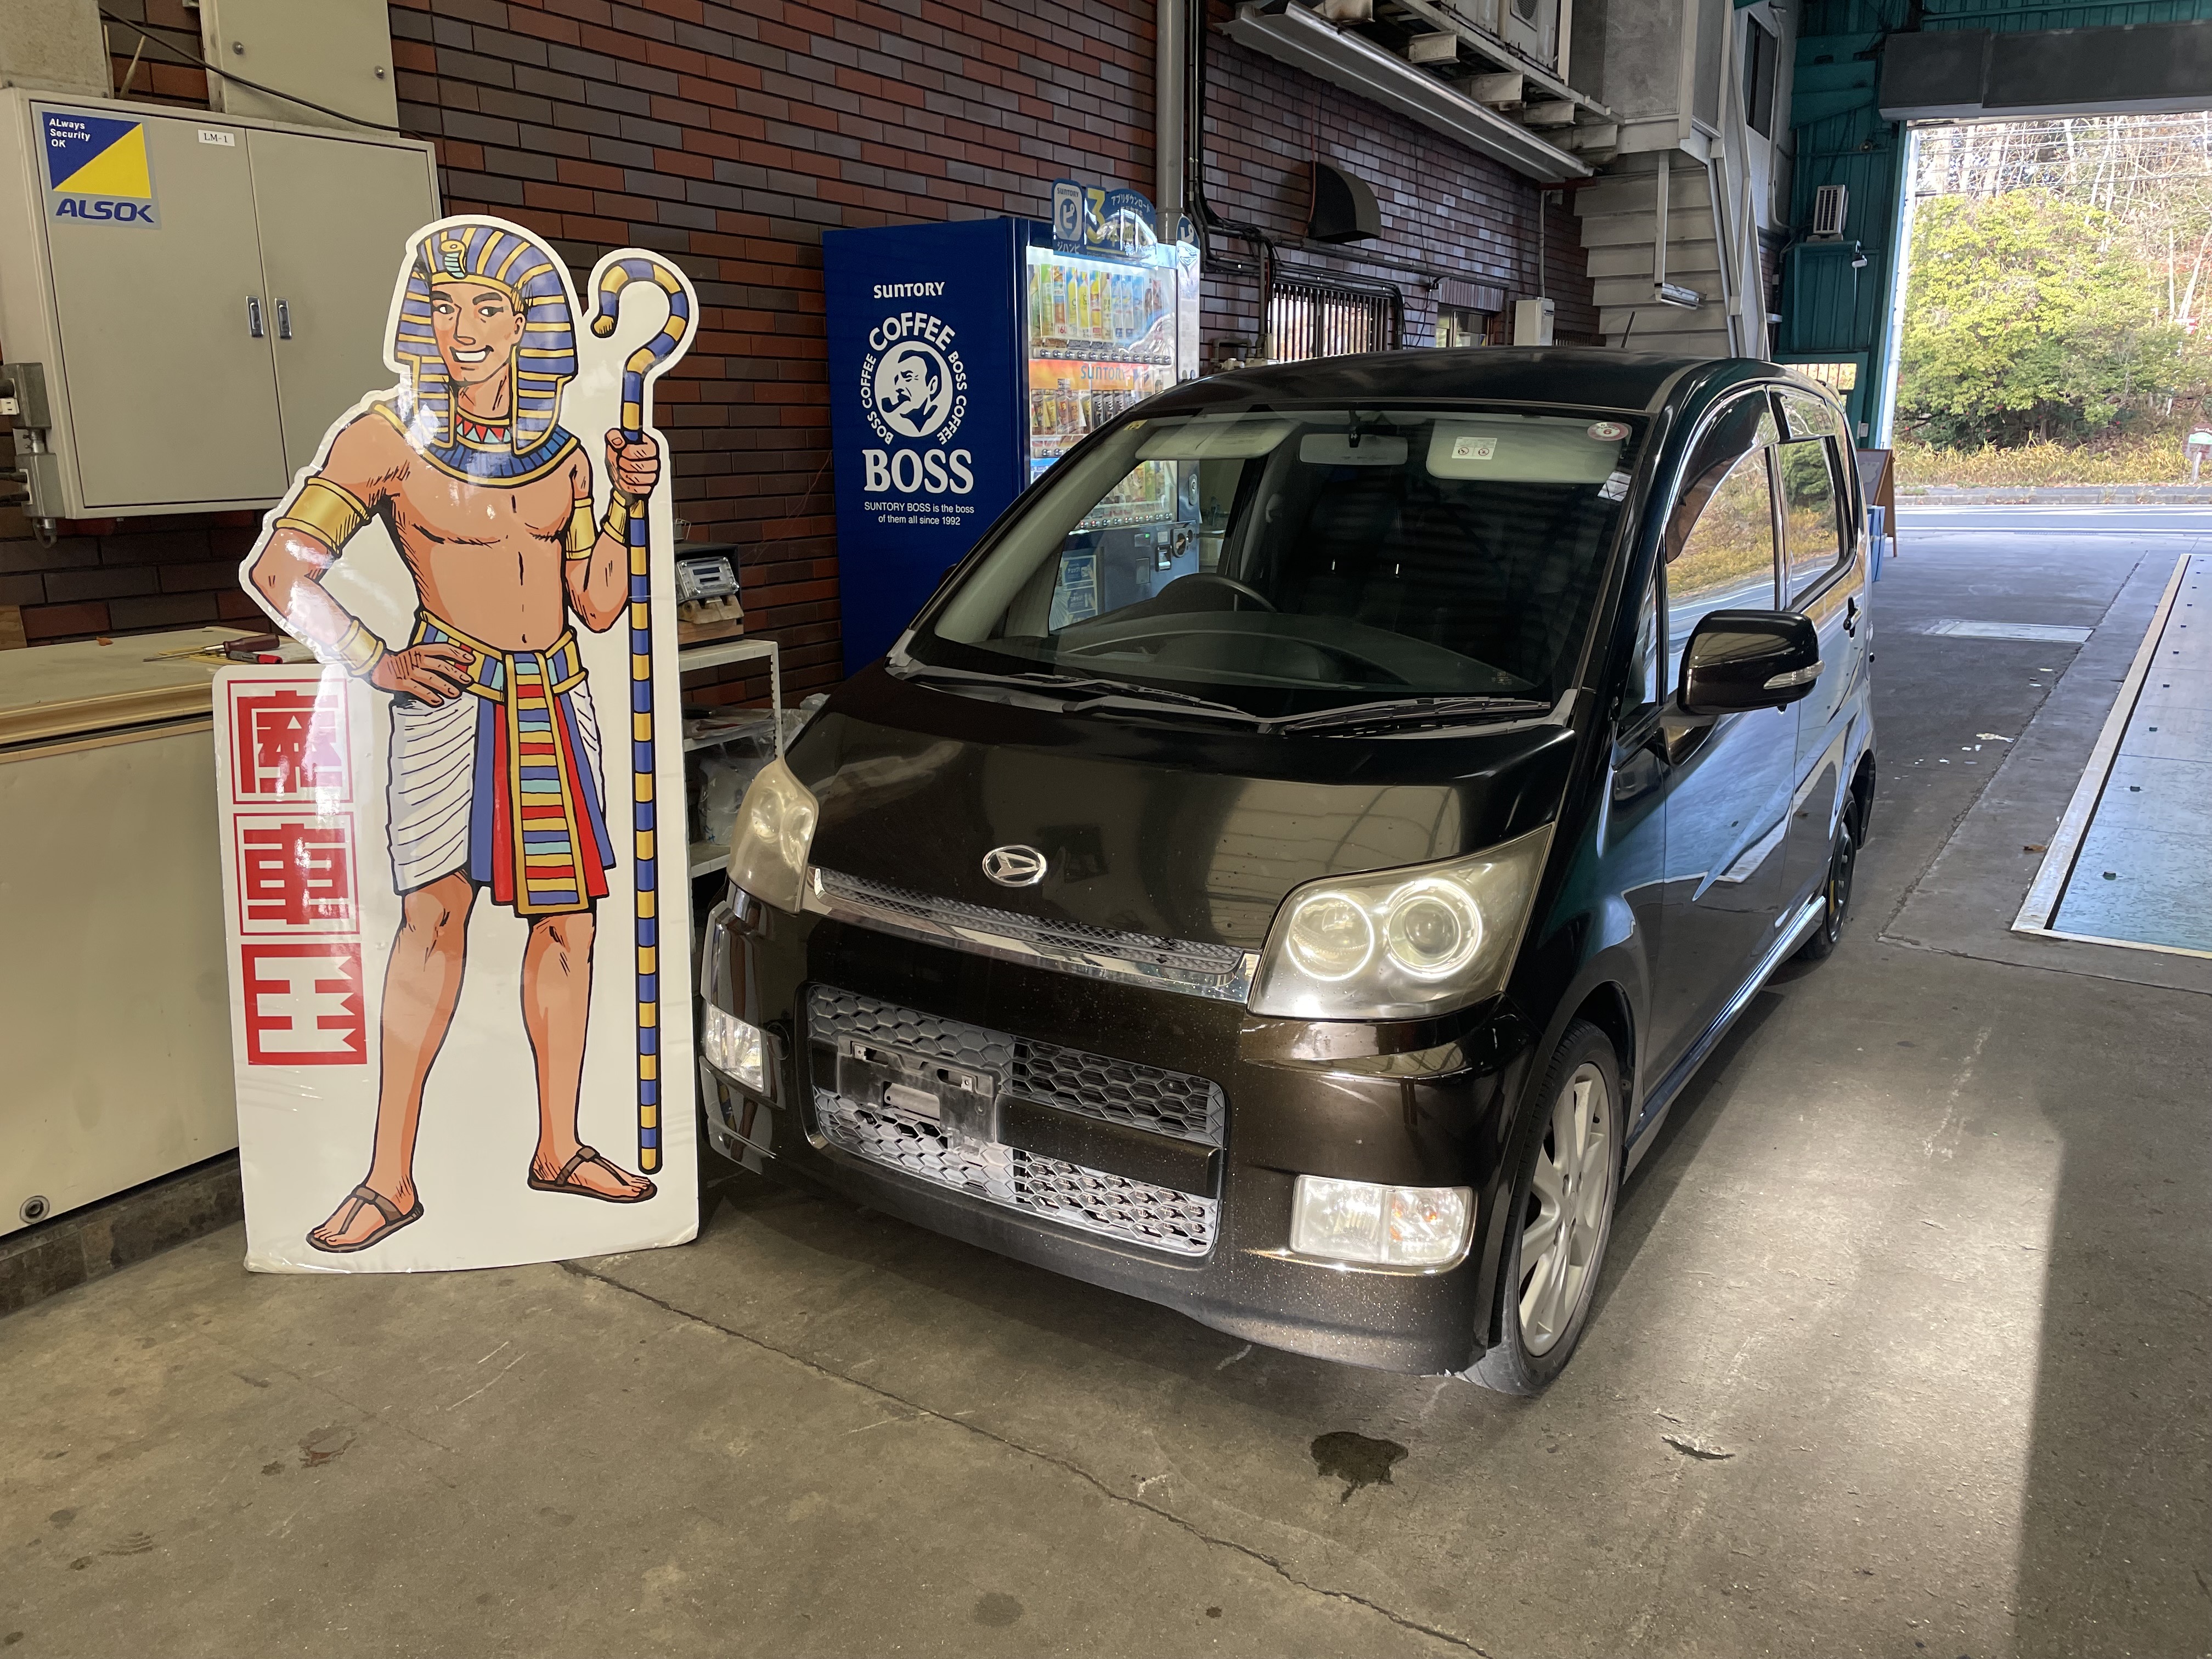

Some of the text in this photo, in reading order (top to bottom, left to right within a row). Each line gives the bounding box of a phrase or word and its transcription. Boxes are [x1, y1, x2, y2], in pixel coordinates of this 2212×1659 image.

[49, 118, 85, 131] ALways
[50, 128, 91, 142] Security
[204, 133, 228, 143] LM-1
[51, 139, 66, 148] OK
[55, 198, 155, 223] ALSOK
[873, 281, 945, 298] SUNTORY
[869, 312, 956, 351] COFFEE
[860, 353, 894, 445] BOSS COFFEE
[936, 351, 967, 445] BOSS COFFEE
[862, 449, 974, 494] BOSS
[864, 501, 974, 514] SUNTORY BOSS is the boss
[878, 514, 961, 525] of them all since 1992
